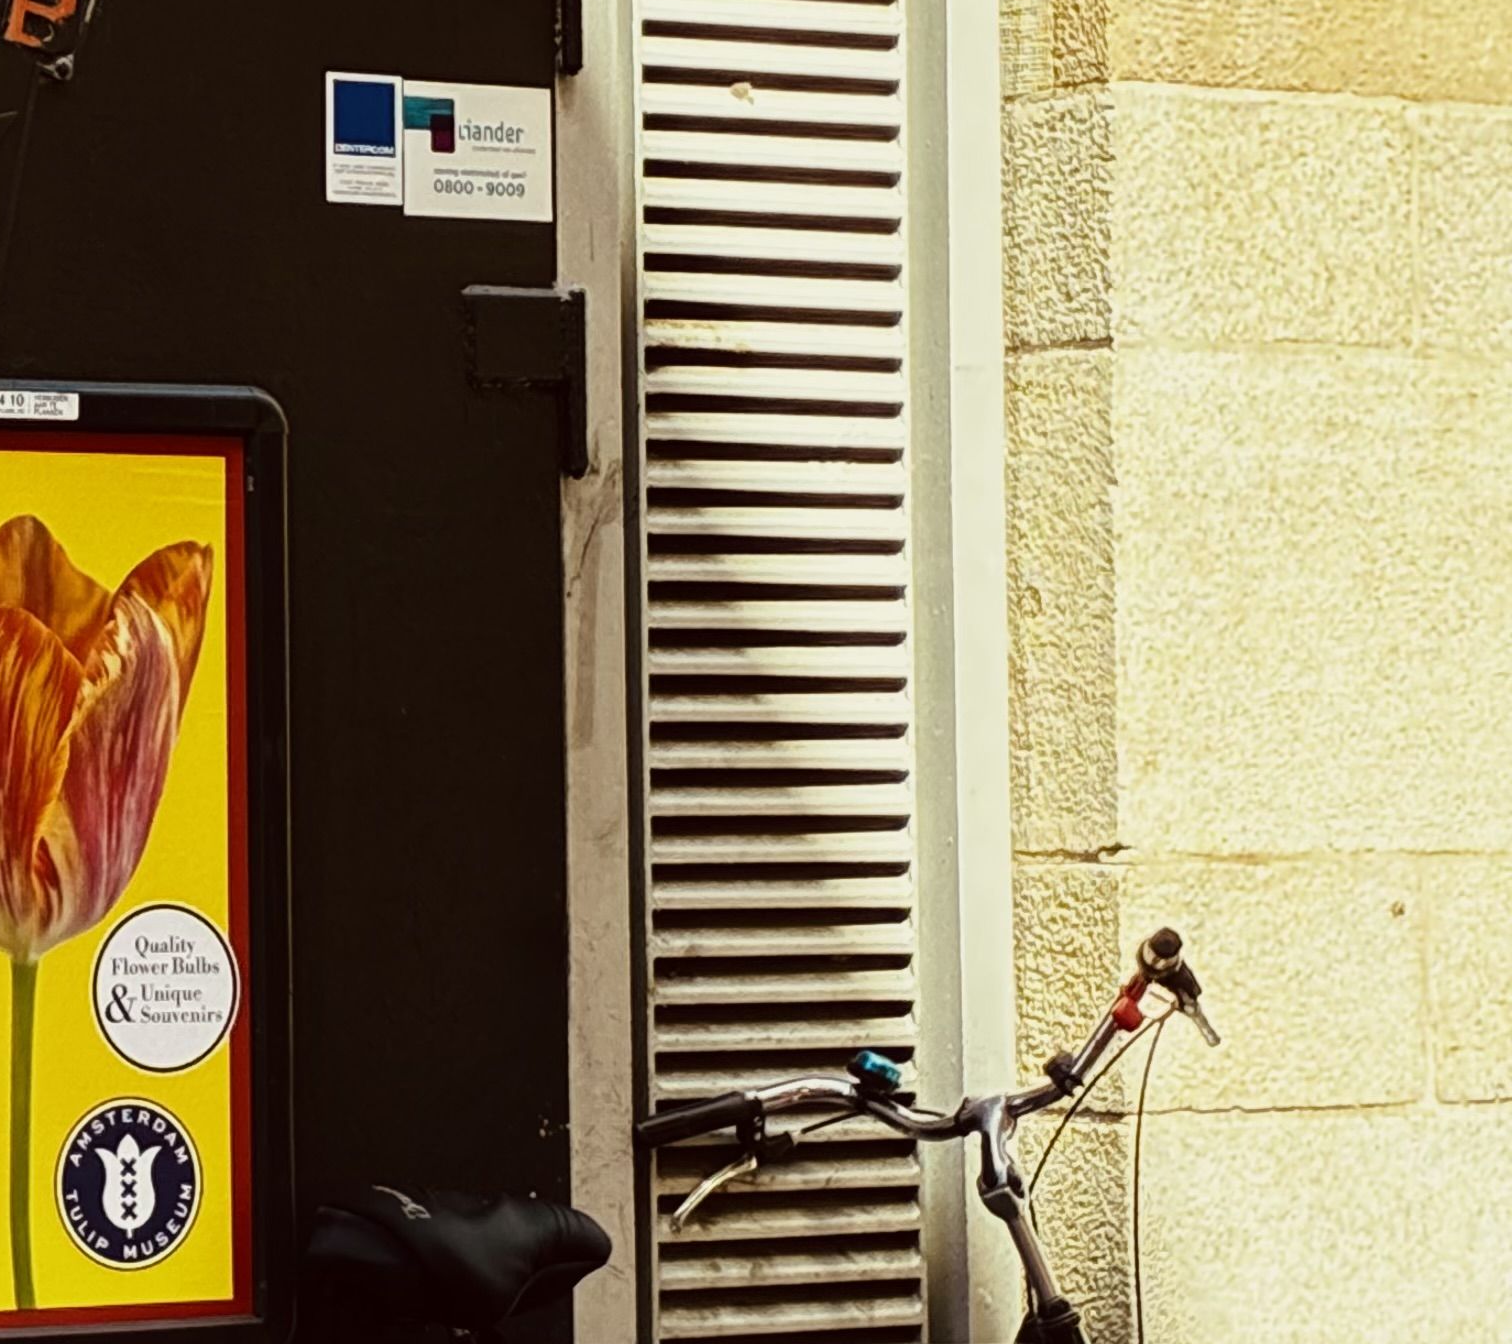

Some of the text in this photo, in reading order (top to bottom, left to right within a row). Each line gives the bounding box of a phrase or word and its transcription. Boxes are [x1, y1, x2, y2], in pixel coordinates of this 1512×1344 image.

[433, 178, 474, 195] 0800
[485, 181, 526, 198] 9009
[10, 394, 25, 408] 10
[135, 936, 195, 958] Quality
[112, 956, 220, 976] Flower Bulbs
[105, 983, 203, 1024] & Unique
[140, 1005, 223, 1025] Souvenirs
[69, 1108, 189, 1167] AMSTERDAM
[66, 1183, 193, 1260] TULIP MUSEUM
